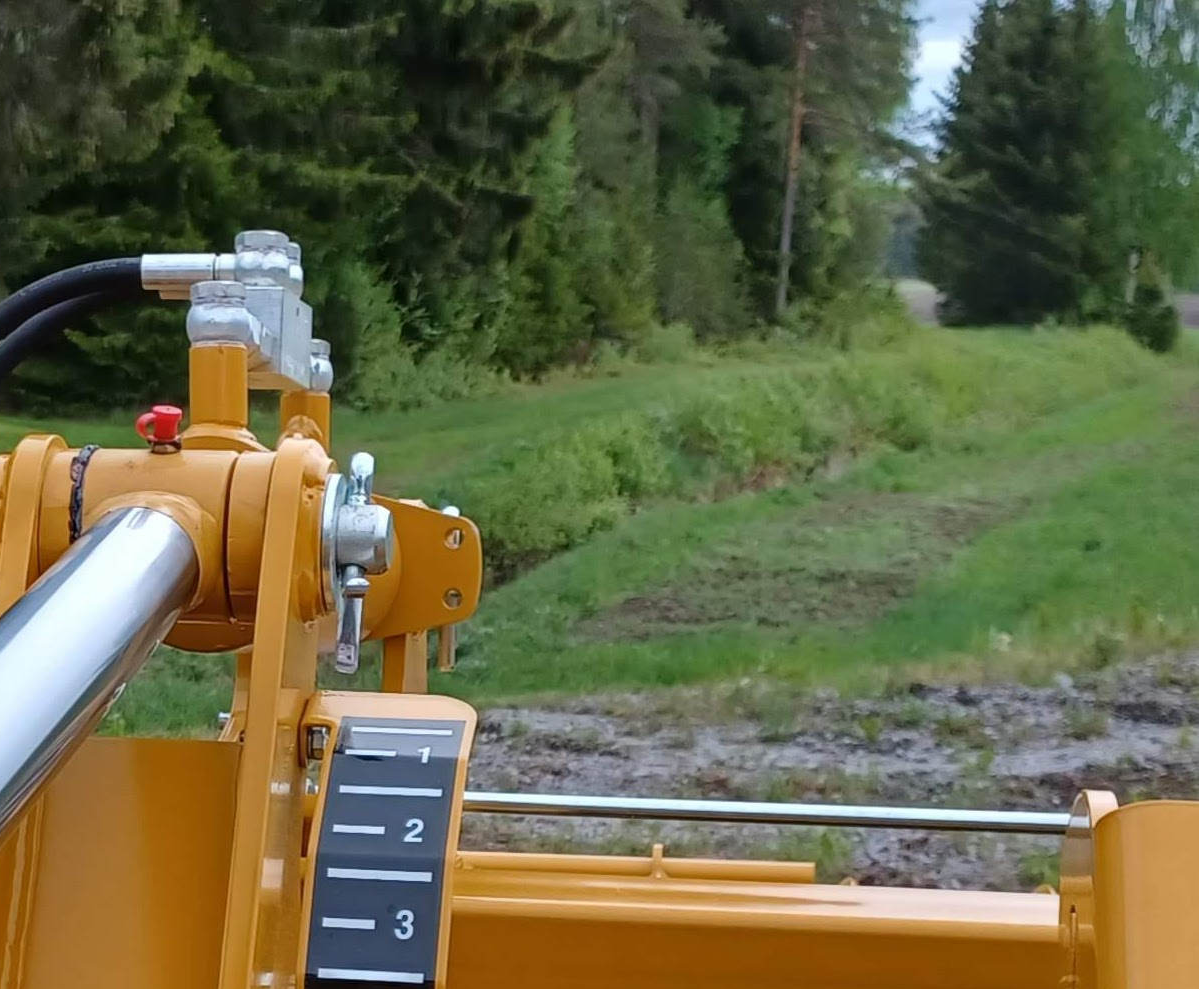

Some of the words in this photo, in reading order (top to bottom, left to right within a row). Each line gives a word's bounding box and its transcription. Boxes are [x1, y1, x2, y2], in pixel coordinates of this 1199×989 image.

[417, 746, 431, 764] 1
[403, 818, 424, 843] 2
[394, 909, 414, 940] 3
